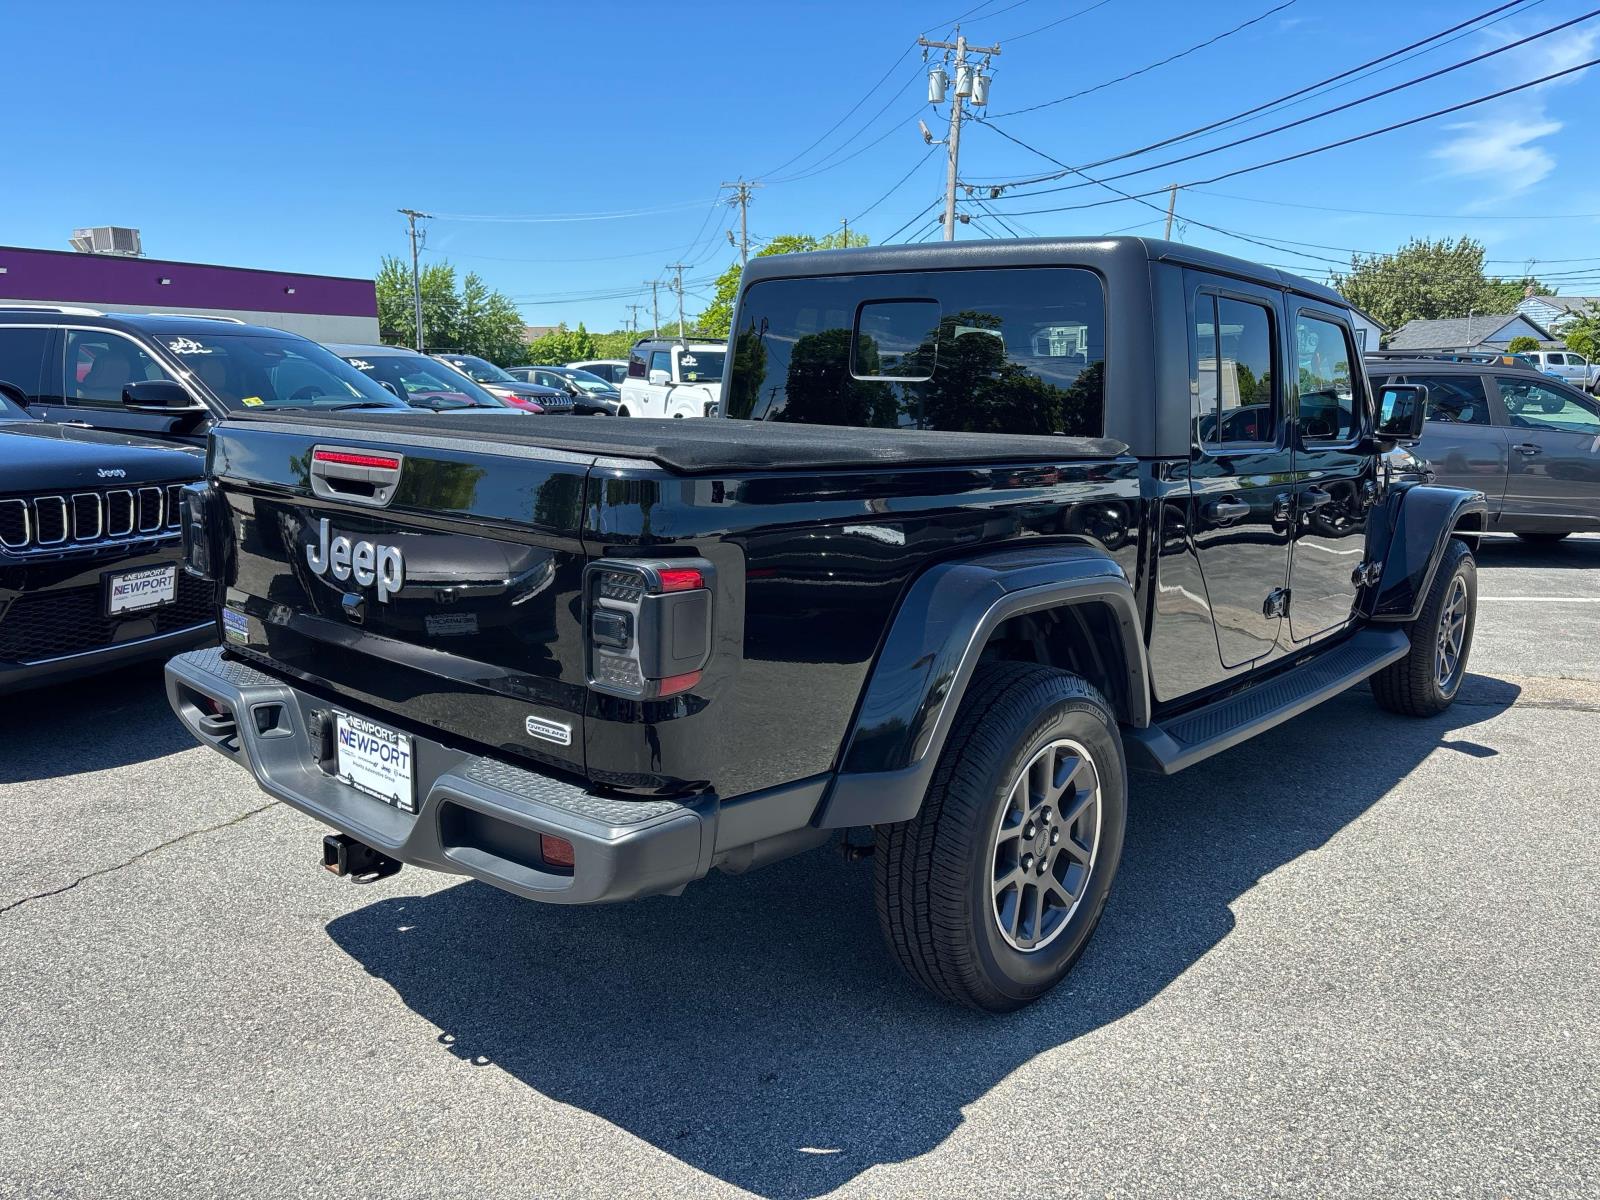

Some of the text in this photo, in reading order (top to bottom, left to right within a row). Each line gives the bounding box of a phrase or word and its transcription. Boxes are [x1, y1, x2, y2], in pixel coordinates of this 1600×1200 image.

[306, 517, 406, 604] Jeep
[127, 568, 165, 581] NEWPORT
[113, 576, 174, 597] NEWPORT
[349, 715, 393, 741] NEWPORT
[527, 723, 568, 739] OVERLAND
[340, 727, 409, 769] NEWPORT
